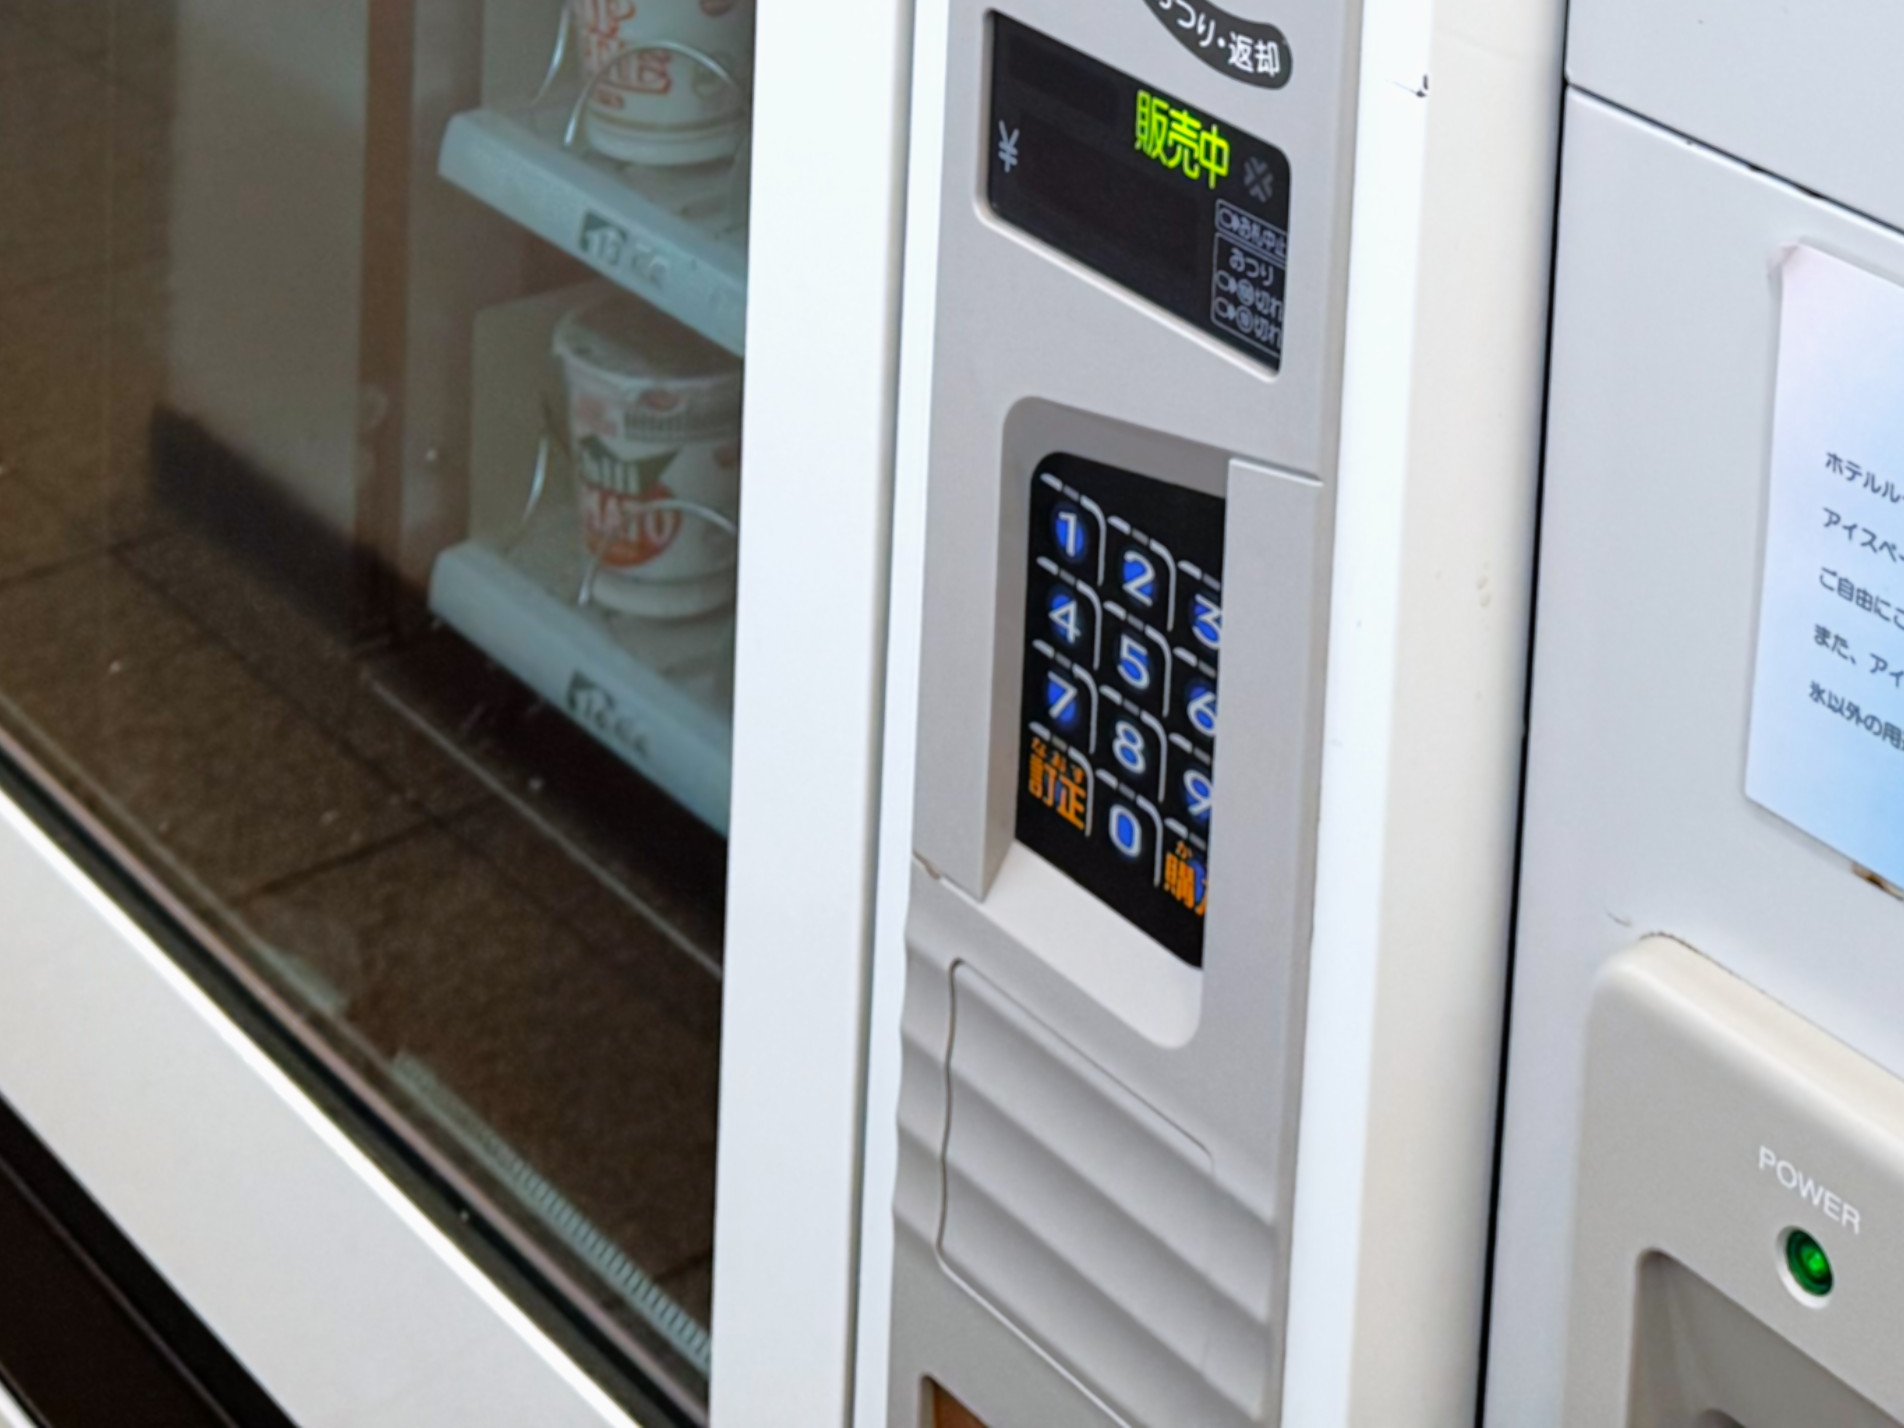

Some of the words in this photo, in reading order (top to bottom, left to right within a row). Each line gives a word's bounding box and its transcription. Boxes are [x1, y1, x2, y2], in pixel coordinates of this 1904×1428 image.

[997, 119, 1020, 172] ¥
[1132, 89, 1231, 190] 販売中
[1228, 248, 1275, 287] おつり
[1057, 510, 1081, 558] 1
[1121, 549, 1155, 607] 2
[1192, 593, 1223, 651] 3
[1048, 599, 1081, 645] 4
[1117, 634, 1152, 690] 5
[1187, 688, 1218, 738] 6
[1046, 671, 1079, 719] 7
[1112, 720, 1147, 777] 8
[1182, 766, 1213, 819] 9
[1028, 754, 1087, 833] 訂正
[1107, 801, 1142, 857] 0
[1757, 1145, 1862, 1235] POWER
